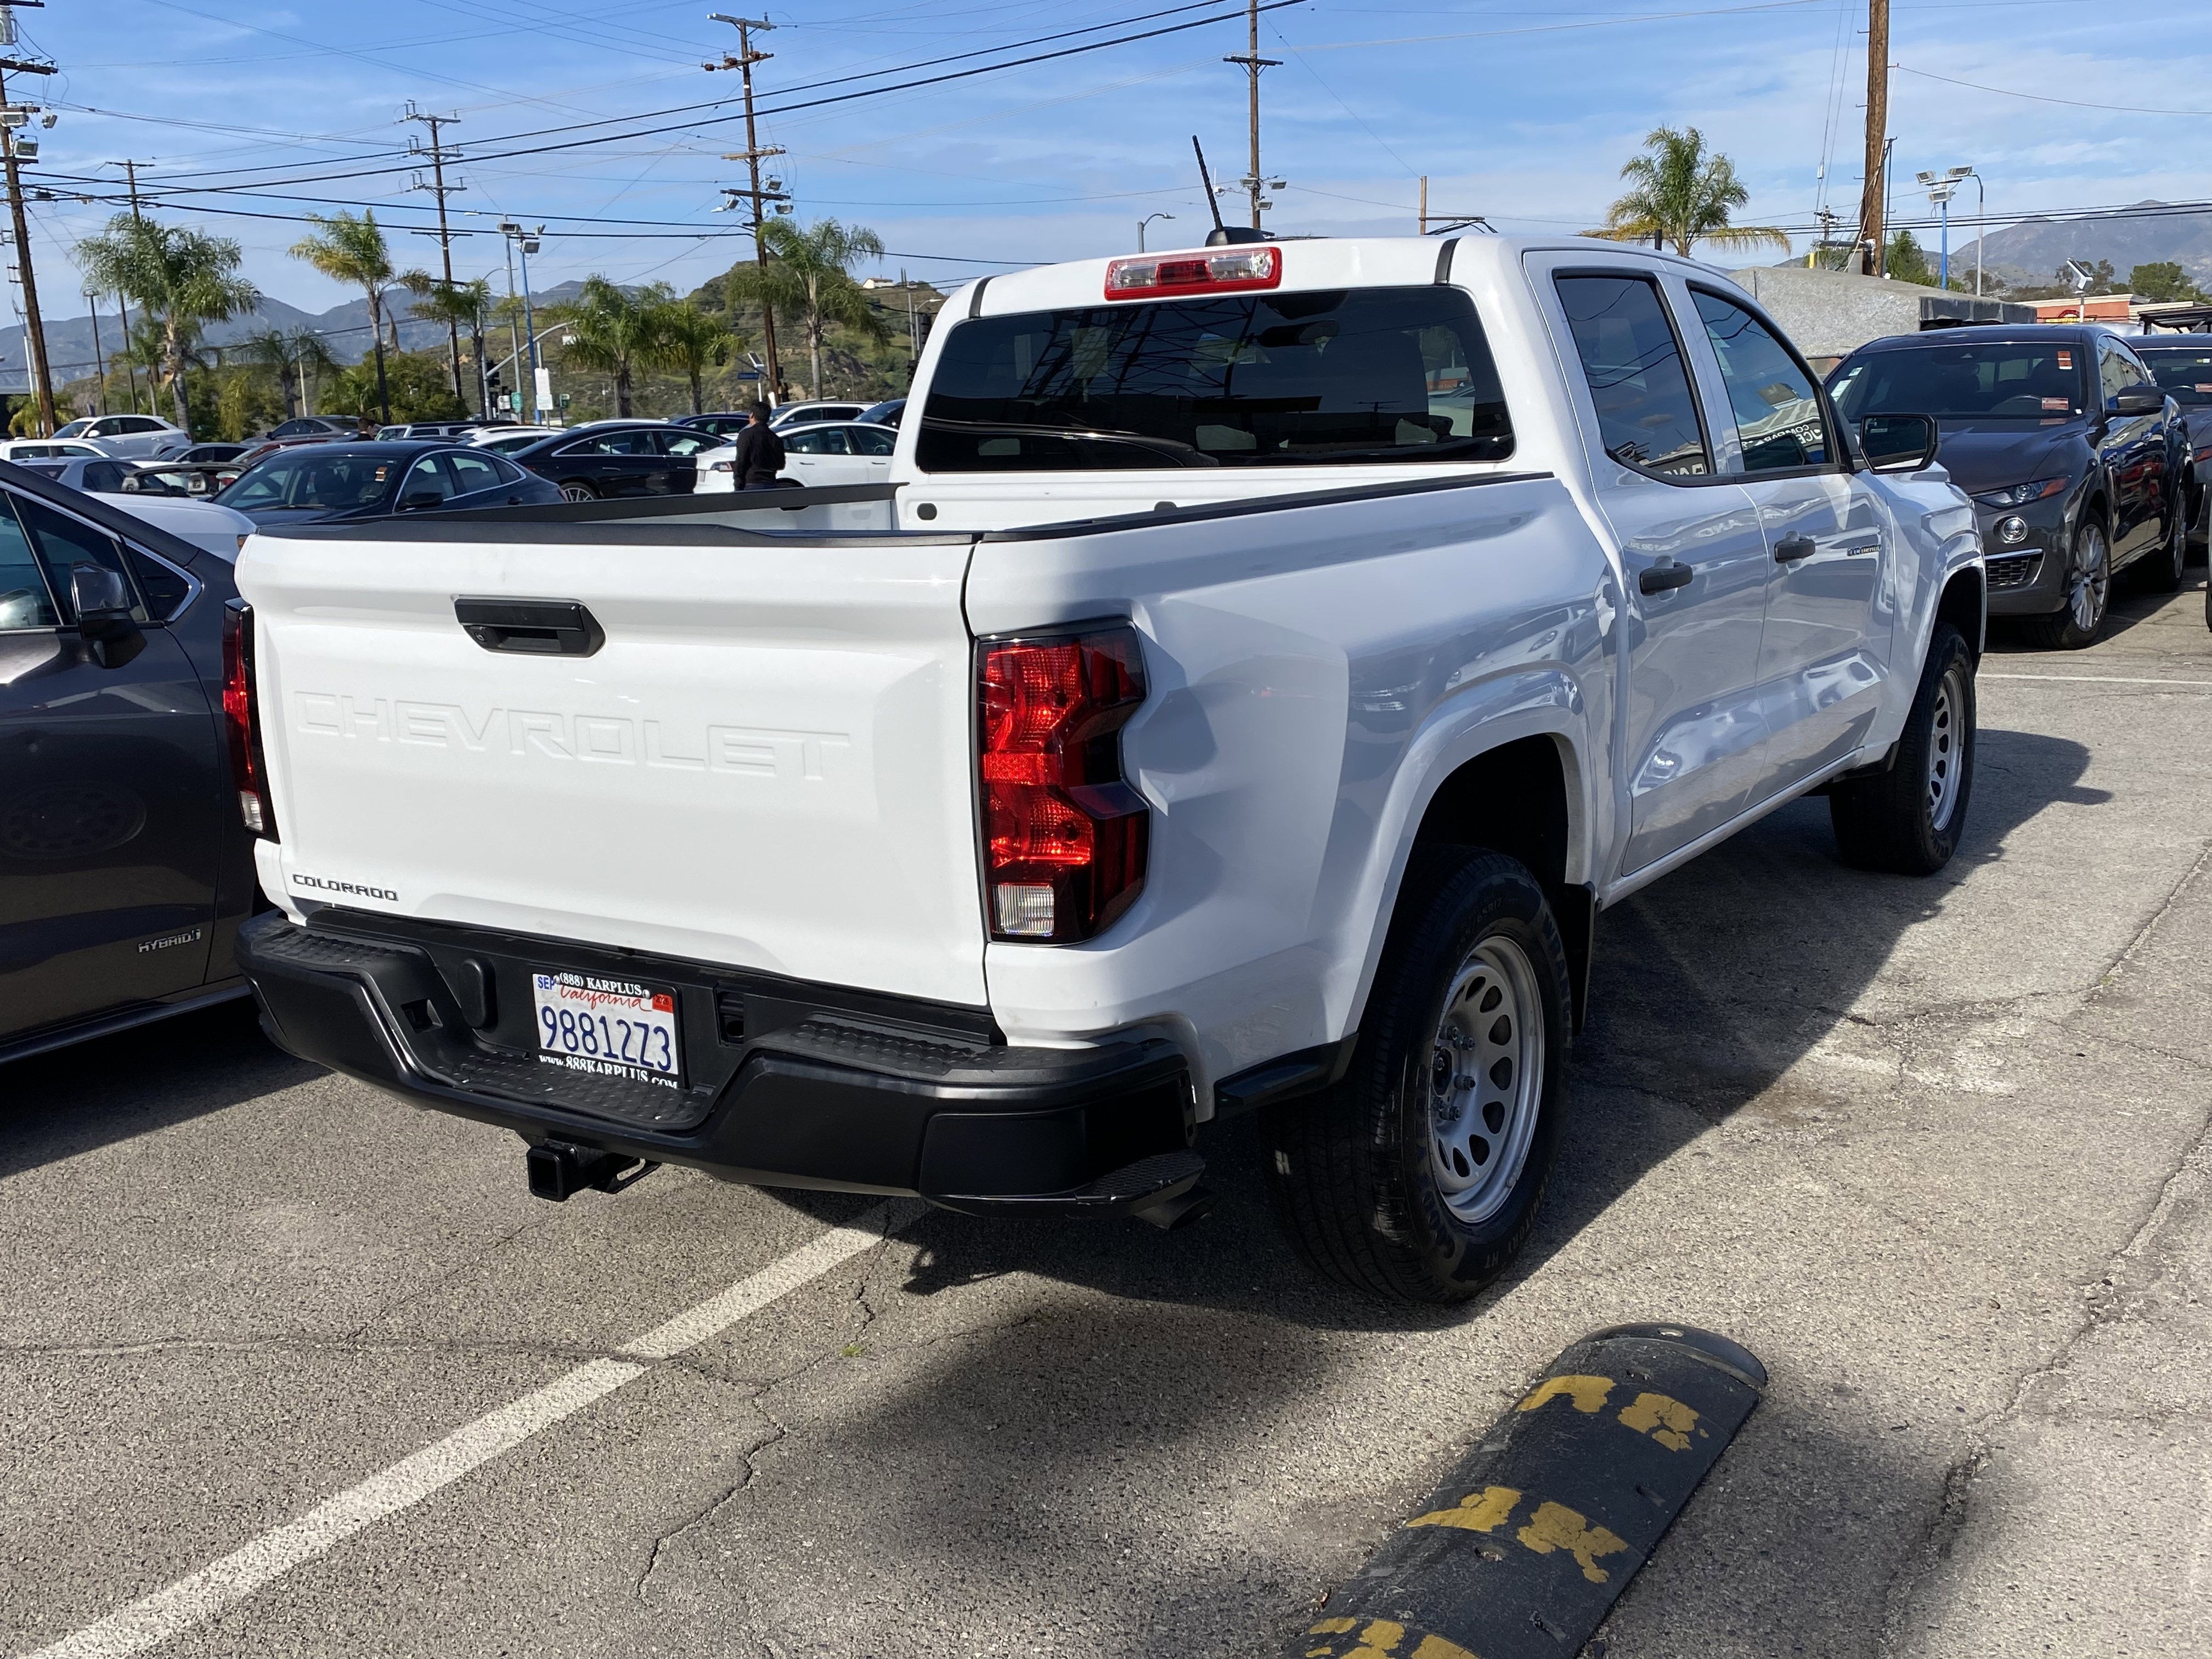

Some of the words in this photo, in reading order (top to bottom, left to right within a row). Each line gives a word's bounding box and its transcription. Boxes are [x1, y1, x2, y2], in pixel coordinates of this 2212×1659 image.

[295, 691, 850, 780] CHEVROLET
[292, 874, 399, 901] COLORADO
[138, 933, 192, 953] HYBRID
[538, 976, 556, 990] SEP
[560, 972, 584, 987] (888)
[586, 977, 642, 996] KARPLUS
[560, 985, 652, 1012] California
[541, 1006, 672, 1071] 98812Z3
